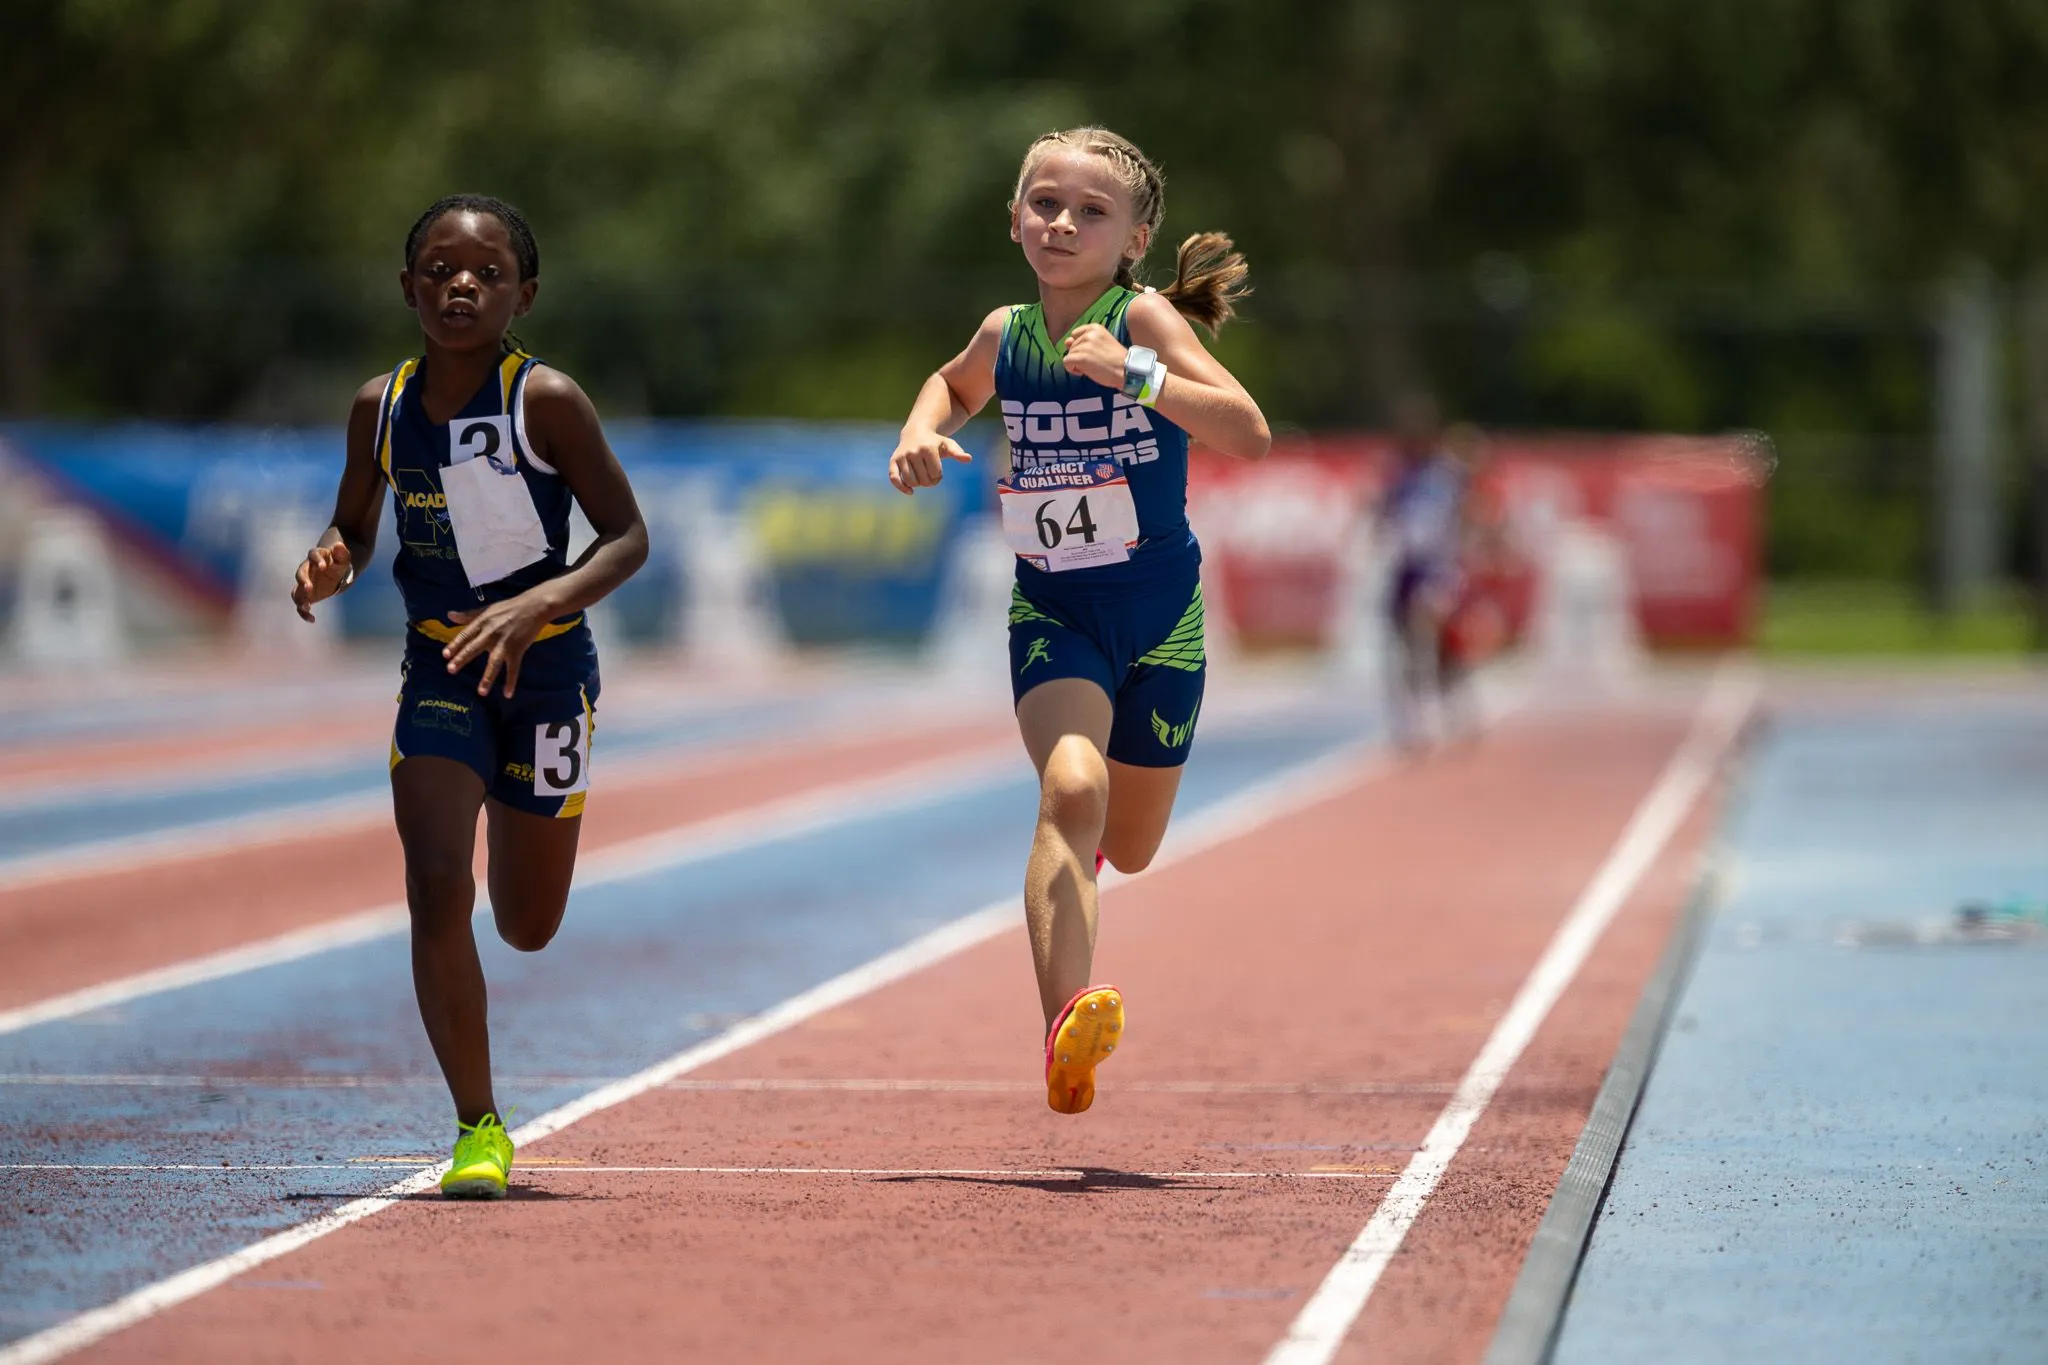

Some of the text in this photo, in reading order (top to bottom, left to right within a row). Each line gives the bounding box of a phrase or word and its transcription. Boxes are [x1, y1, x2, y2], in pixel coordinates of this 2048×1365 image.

[1024, 462, 1086, 475] DISTRICT
[1019, 474, 1094, 489] QUALIFIER
[406, 492, 448, 508] ACAD
[1035, 495, 1098, 549] 64
[417, 699, 470, 714] ACADEMY
[543, 717, 581, 789] 3
